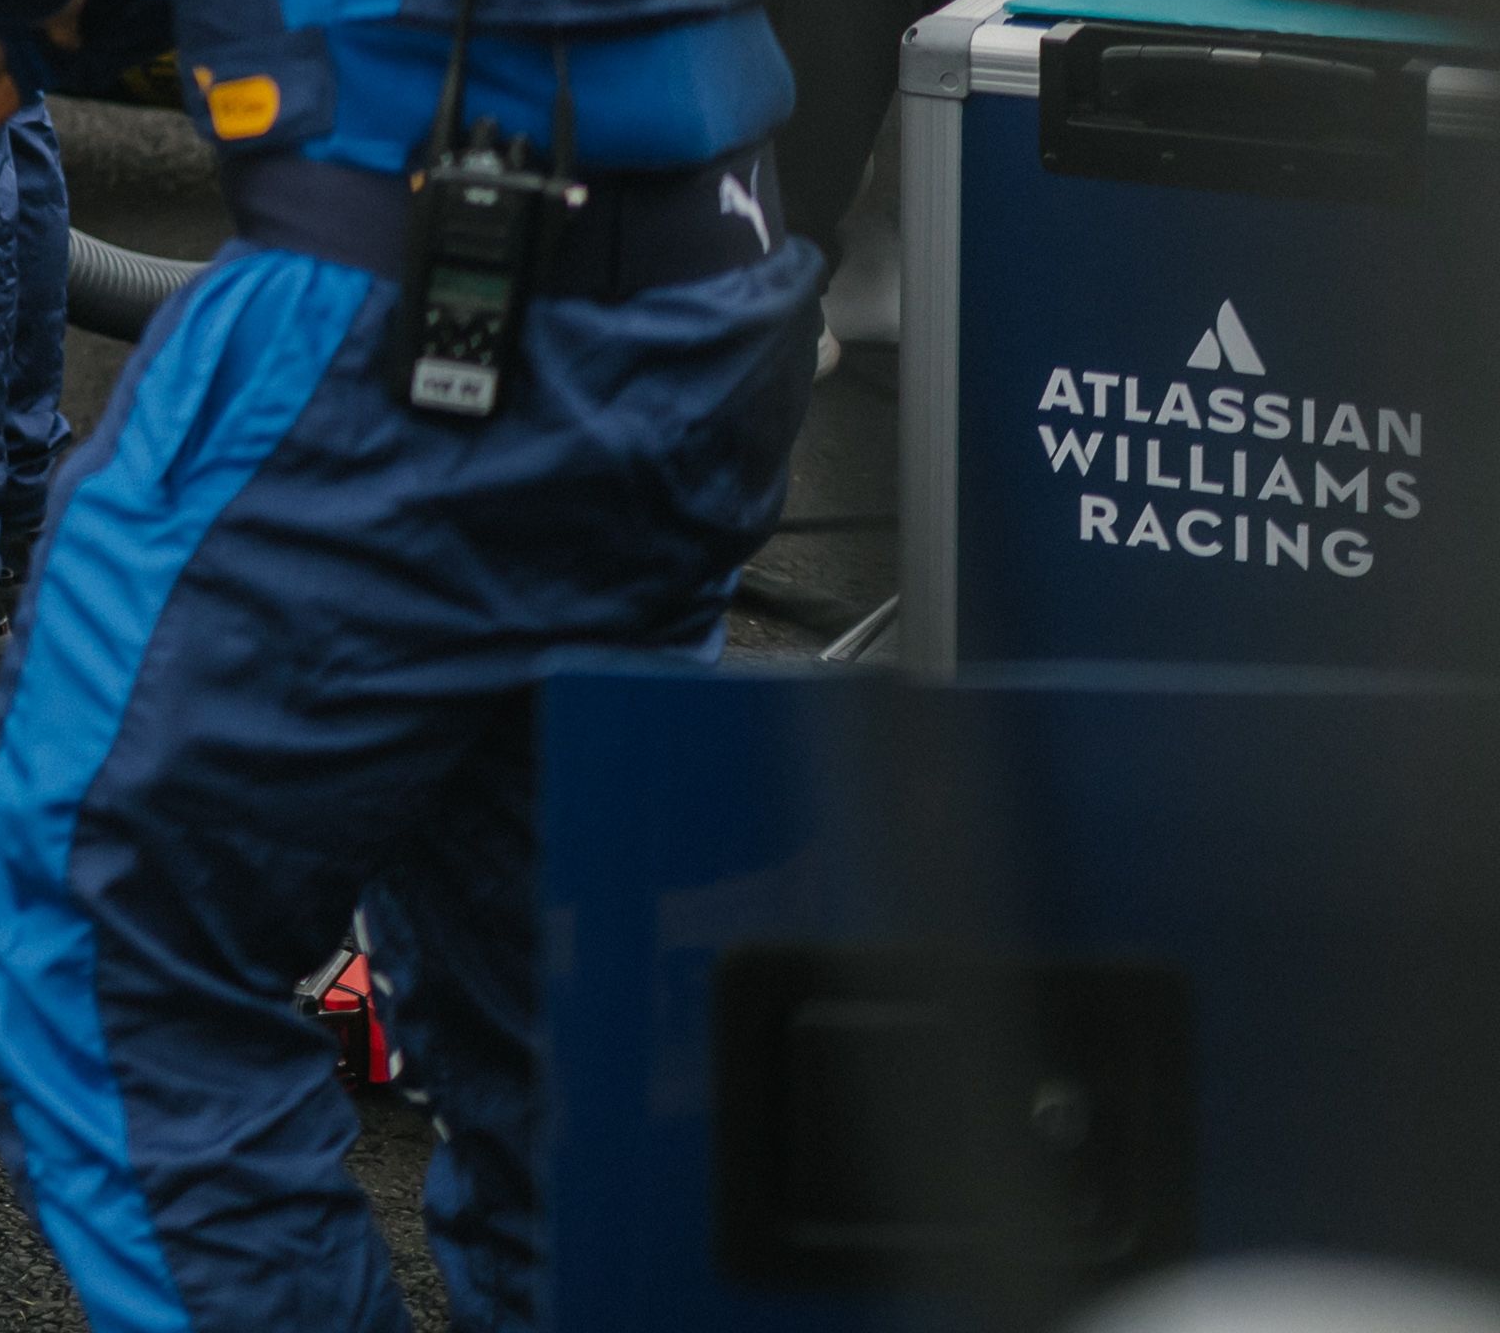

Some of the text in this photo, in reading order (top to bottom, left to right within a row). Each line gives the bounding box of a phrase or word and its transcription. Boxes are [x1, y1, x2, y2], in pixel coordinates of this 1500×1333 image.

[1038, 367, 1422, 457] ATLASSIAN
[1038, 424, 1421, 520] WILLIAMS
[1079, 494, 1375, 578] RACING
